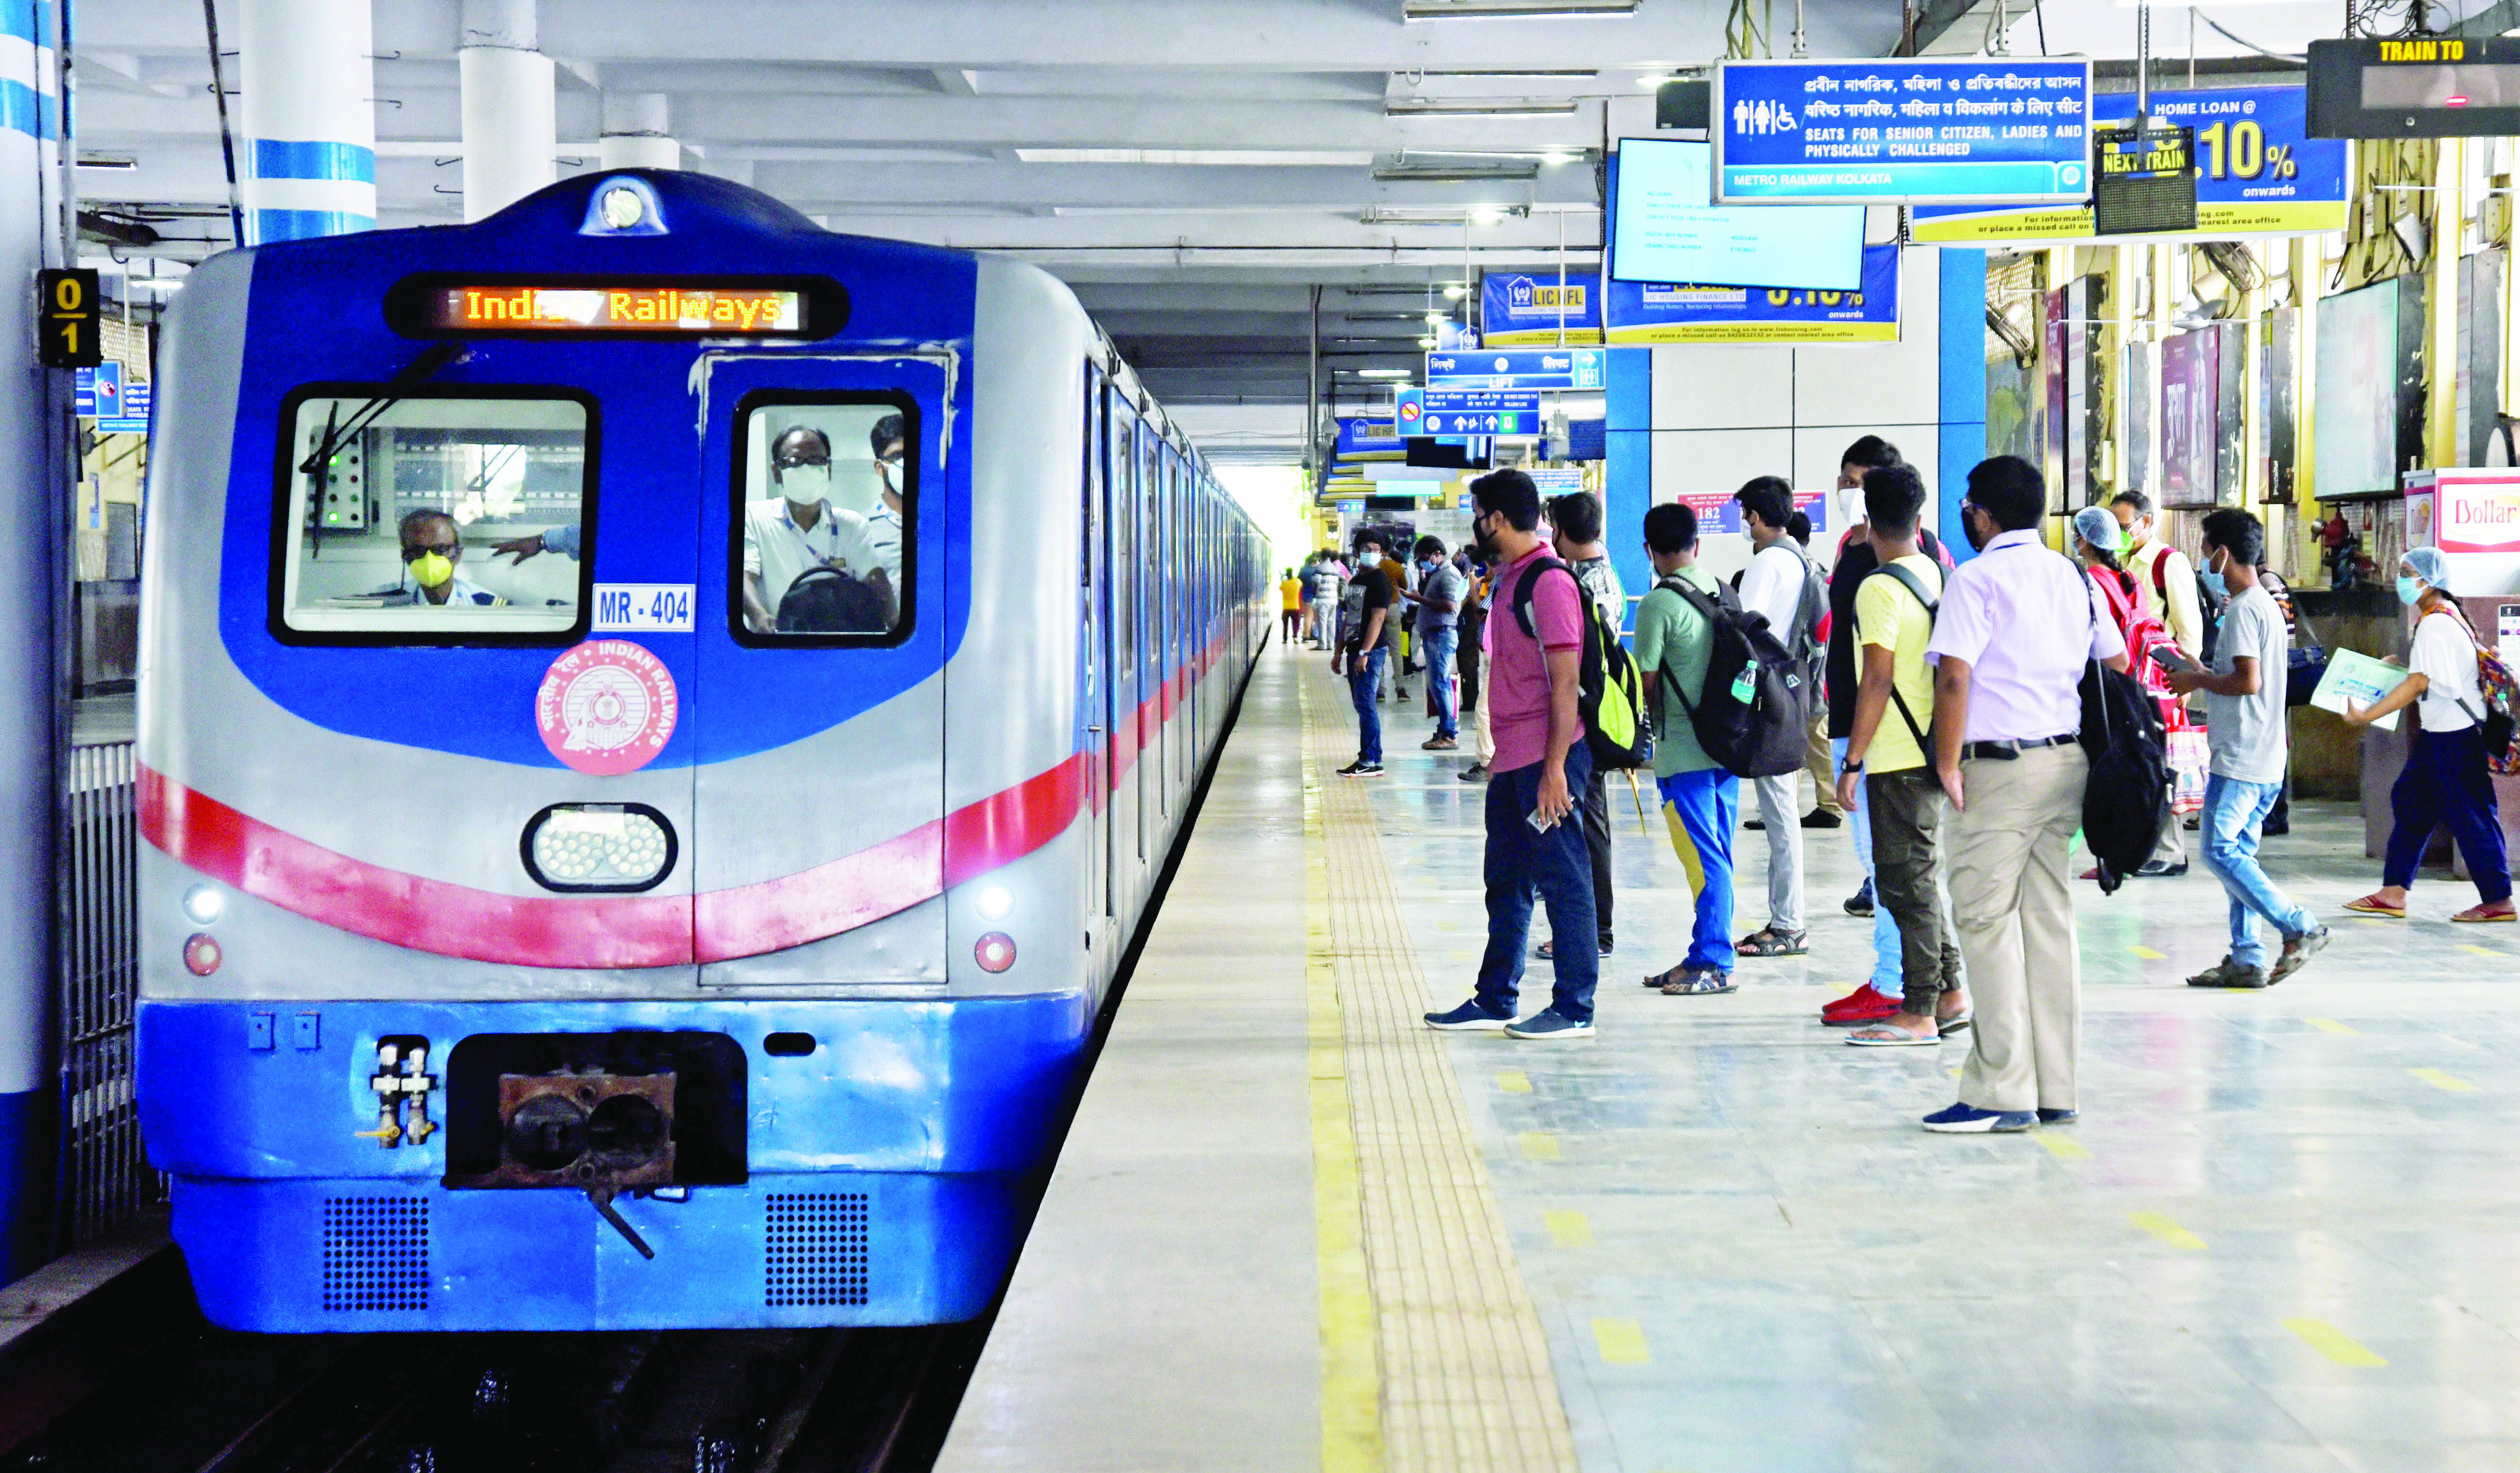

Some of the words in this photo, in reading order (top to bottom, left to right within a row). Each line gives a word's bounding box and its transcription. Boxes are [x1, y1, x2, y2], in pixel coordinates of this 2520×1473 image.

[2380, 40, 2437, 62] TRAIN
[2440, 40, 2464, 61] TO
[1903, 74, 1942, 91] মহিলা
[1948, 79, 1961, 91] ও
[2044, 76, 2082, 89] আসন
[1804, 100, 1841, 117] वरिष्ठ
[1843, 100, 1897, 118] नागरिक,
[1900, 99, 1940, 117] महिला
[1942, 102, 1953, 116] व
[1956, 98, 2008, 115] विकलांग
[2011, 97, 2025, 115] के
[2027, 97, 2054, 116] लिए
[2055, 96, 2083, 114] सीट
[2155, 103, 2197, 116] HOME
[2201, 102, 2240, 115] LOAN
[2243, 100, 2257, 114] @
[1805, 128, 1845, 142] SEATS
[1853, 127, 1878, 141] FOR
[1886, 127, 1933, 141] SENIOR
[1941, 126, 1995, 140] CITIZEN,
[2002, 125, 2048, 138] LADIES
[2056, 125, 2082, 138] AND
[1805, 144, 1880, 158] PHYSICALLY
[1889, 143, 1970, 156] CHALLENGED
[2146, 150, 2185, 170] TRAIN
[1734, 174, 1778, 186] METRO
[1781, 173, 1833, 186] RAILWAY
[1836, 173, 1892, 185] KOLKATA
[2243, 185, 2296, 197] onwards
[1991, 225, 2014, 234] place
[1533, 289, 1554, 305] LIC
[610, 290, 780, 329] Railways
[1828, 310, 1864, 318] onwards
[61, 323, 78, 353] 1
[1489, 377, 1514, 388] LIFT
[1698, 507, 1720, 519] 182
[2455, 499, 2518, 524] Dollar
[600, 591, 631, 623] MR
[651, 591, 688, 623] 404
[599, 642, 655, 670] INDIAN
[649, 668, 675, 747] RAILWAYS
